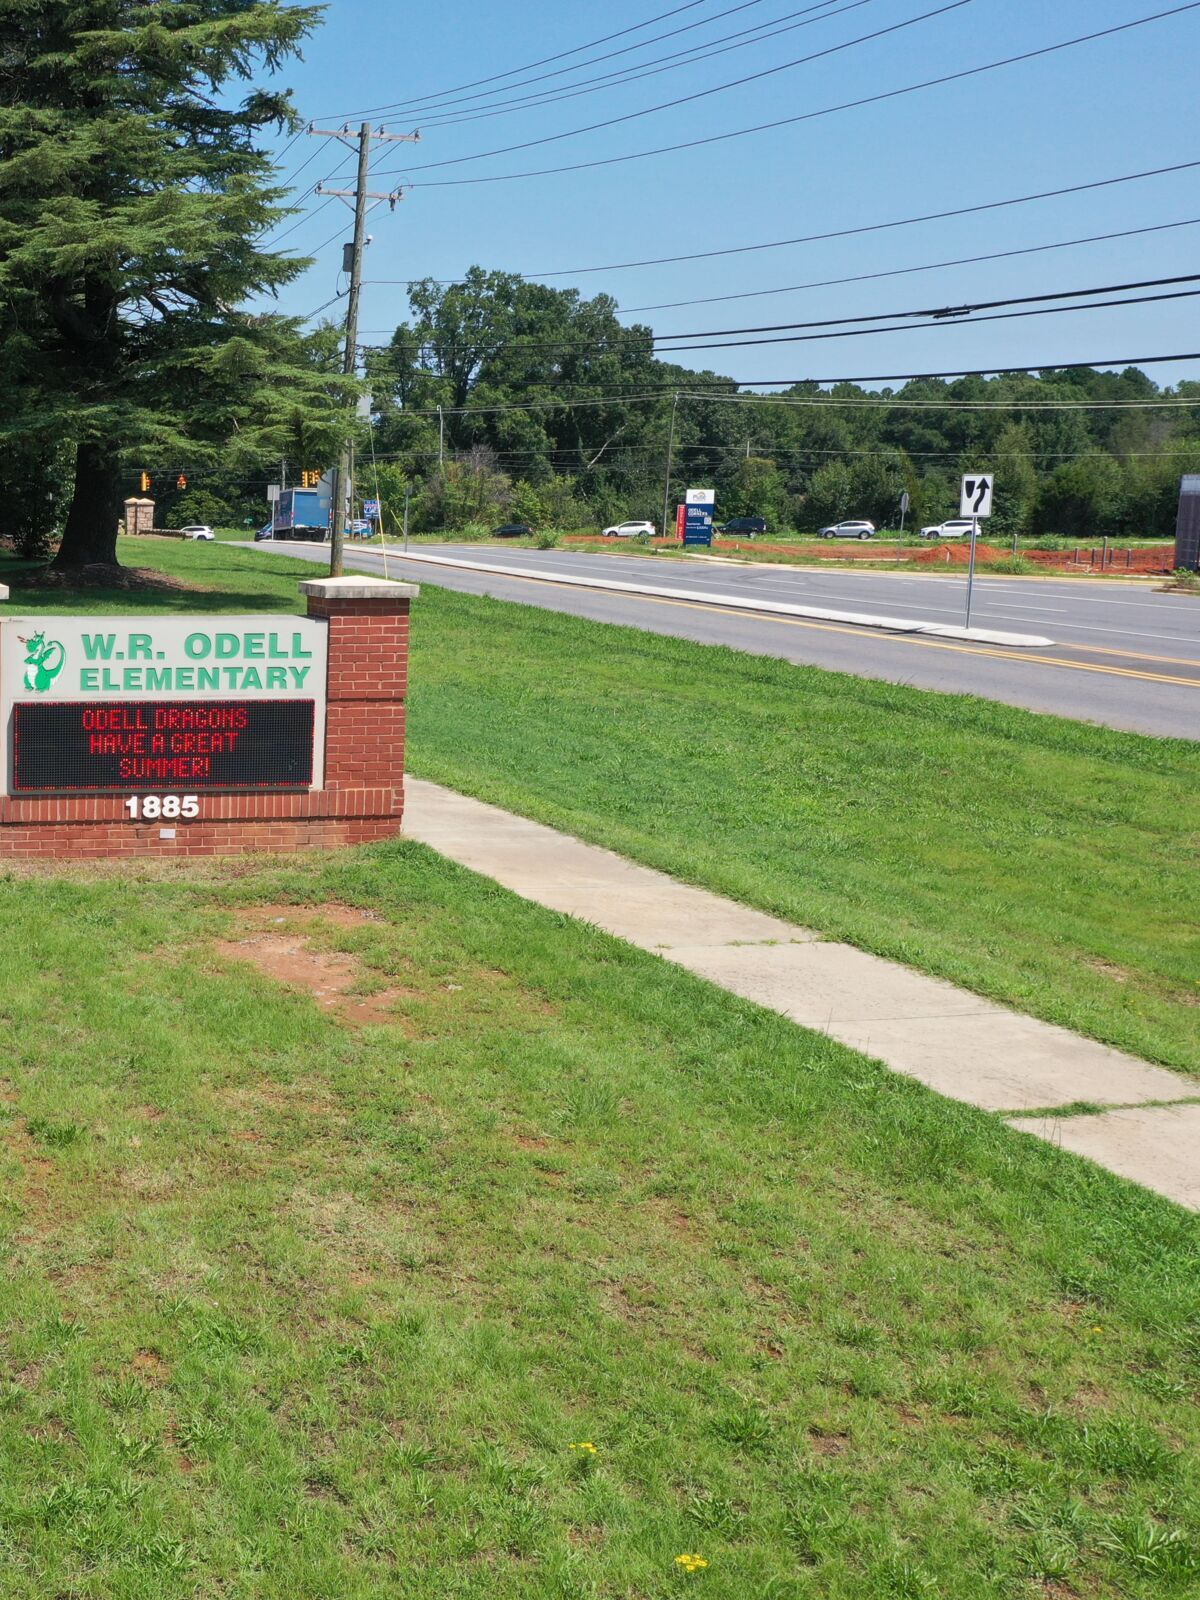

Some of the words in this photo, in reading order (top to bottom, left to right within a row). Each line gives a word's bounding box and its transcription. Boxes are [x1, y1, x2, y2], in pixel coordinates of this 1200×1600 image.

[81, 634, 165, 660] W.R.
[184, 633, 312, 659] ODELL
[80, 666, 310, 691] ELEMENTARY
[83, 709, 148, 730] ODELL
[155, 708, 249, 729] DRAGONS
[90, 733, 145, 754] HAVE
[152, 733, 164, 753] A
[171, 732, 239, 753] GREAT
[120, 757, 209, 778] SUMMER!
[126, 795, 199, 818] 1885
